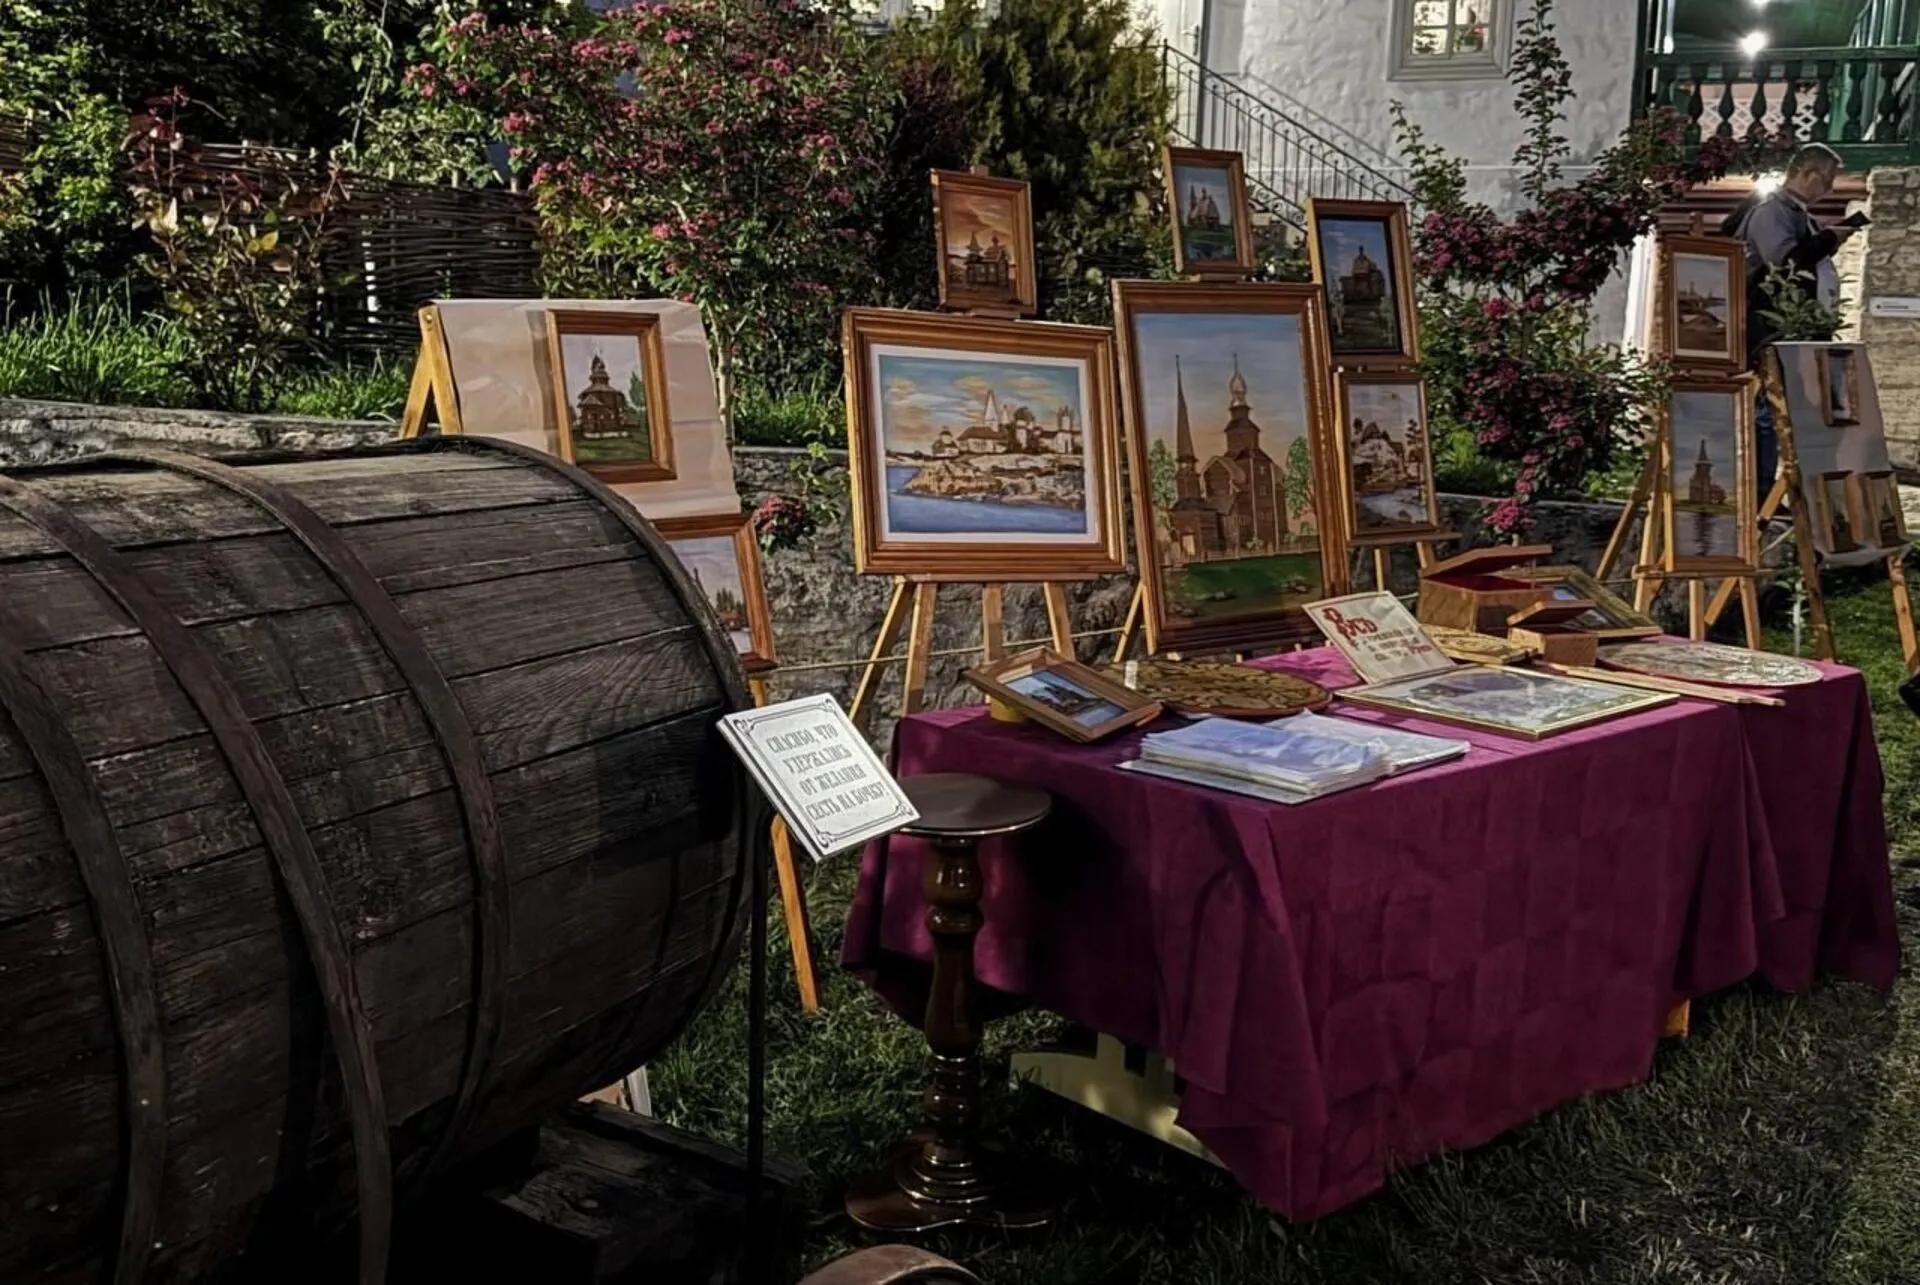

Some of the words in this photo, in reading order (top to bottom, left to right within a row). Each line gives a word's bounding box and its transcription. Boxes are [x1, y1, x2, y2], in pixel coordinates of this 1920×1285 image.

[766, 728, 819, 753] СПАСИБО,
[814, 722, 840, 741] ЧТО
[782, 743, 852, 774] УДЕРЖАЛИСЬ
[799, 777, 819, 796] ОТ
[814, 763, 867, 791] ЖЕЛАНИЯ
[805, 798, 842, 821] СЕСТЬ
[837, 793, 856, 811] НА
